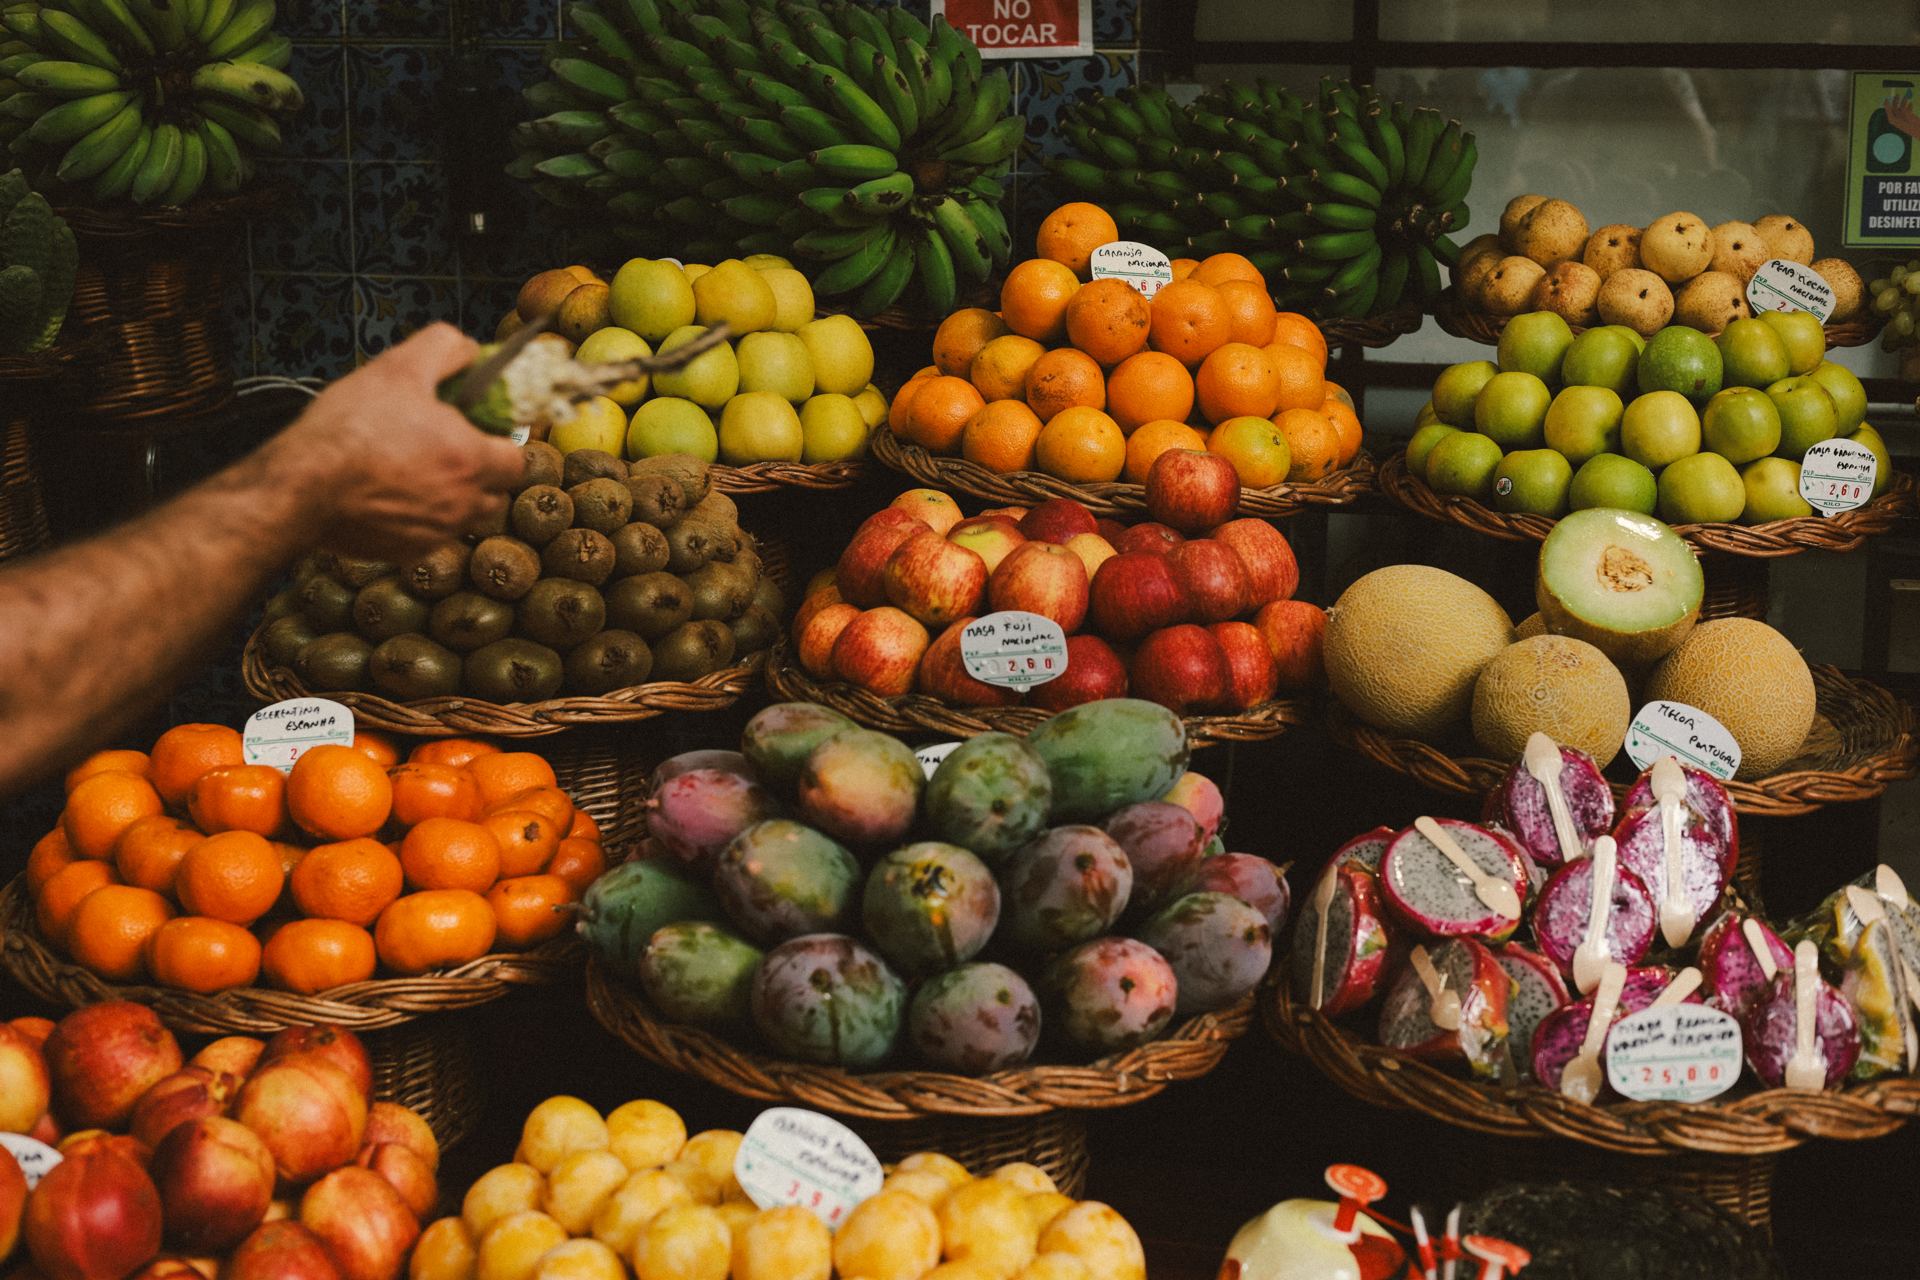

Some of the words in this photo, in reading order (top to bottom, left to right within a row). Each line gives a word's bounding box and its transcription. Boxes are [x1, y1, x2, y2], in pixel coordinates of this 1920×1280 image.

[993, 0, 1031, 19] NO
[966, 23, 1057, 45] TOCAR
[1878, 181, 1902, 194] POR
[1882, 198, 1920, 211] UTILIZ
[285, 715, 336, 731] ESPANHA
